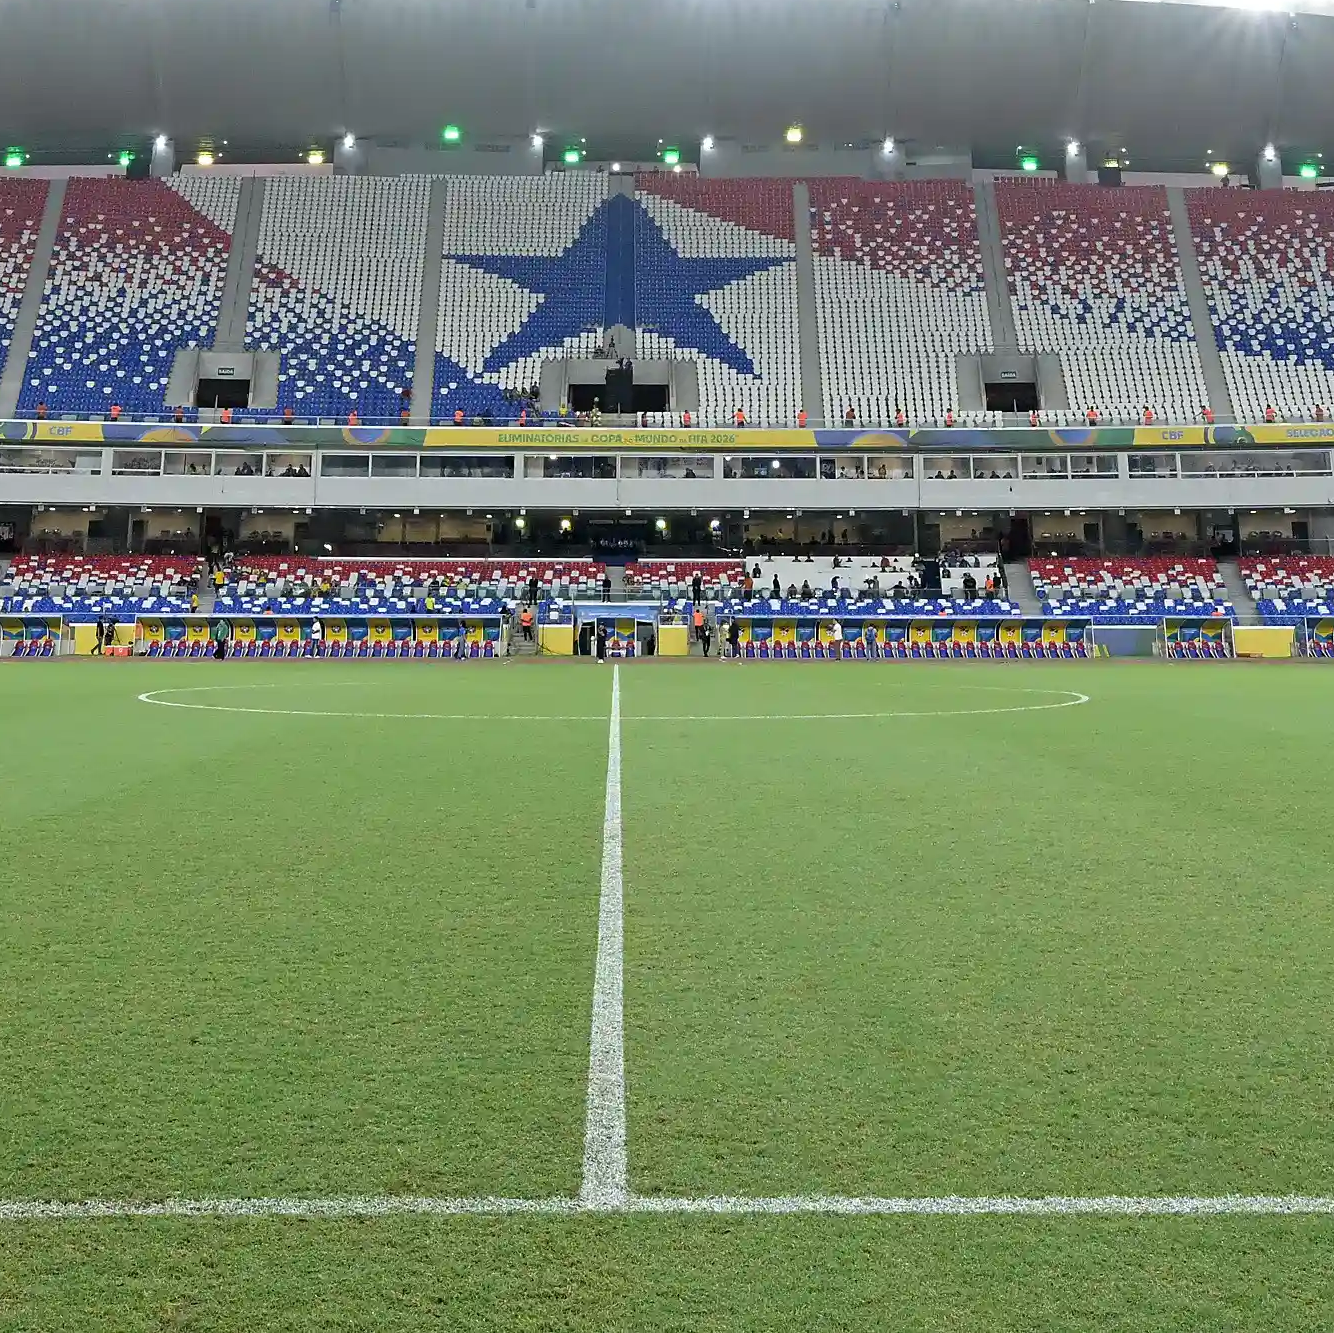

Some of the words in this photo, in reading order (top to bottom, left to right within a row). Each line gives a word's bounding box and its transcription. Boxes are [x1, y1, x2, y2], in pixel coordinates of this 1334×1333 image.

[49, 426, 73, 436] CBF
[1161, 430, 1184, 440] CBF
[591, 433, 623, 443] COPA
[634, 434, 677, 443] MUNDO
[688, 434, 708, 443] FIFA
[710, 434, 735, 443] 2026
